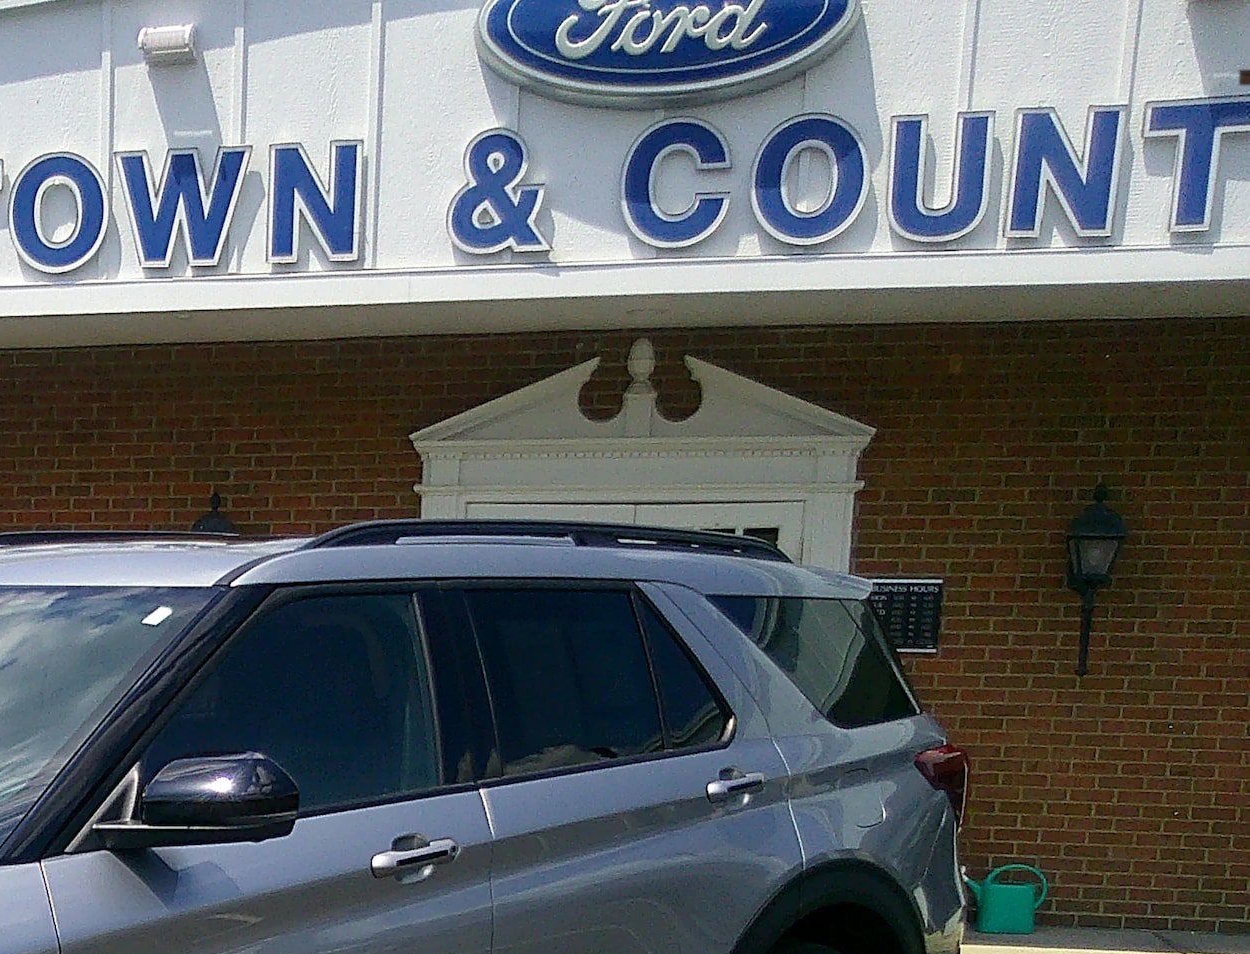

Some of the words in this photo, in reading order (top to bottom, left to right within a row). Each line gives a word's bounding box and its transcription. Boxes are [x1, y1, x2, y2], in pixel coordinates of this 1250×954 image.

[555, 0, 768, 60] Ford
[447, 127, 551, 254] &
[910, 585, 939, 593] HOURS
